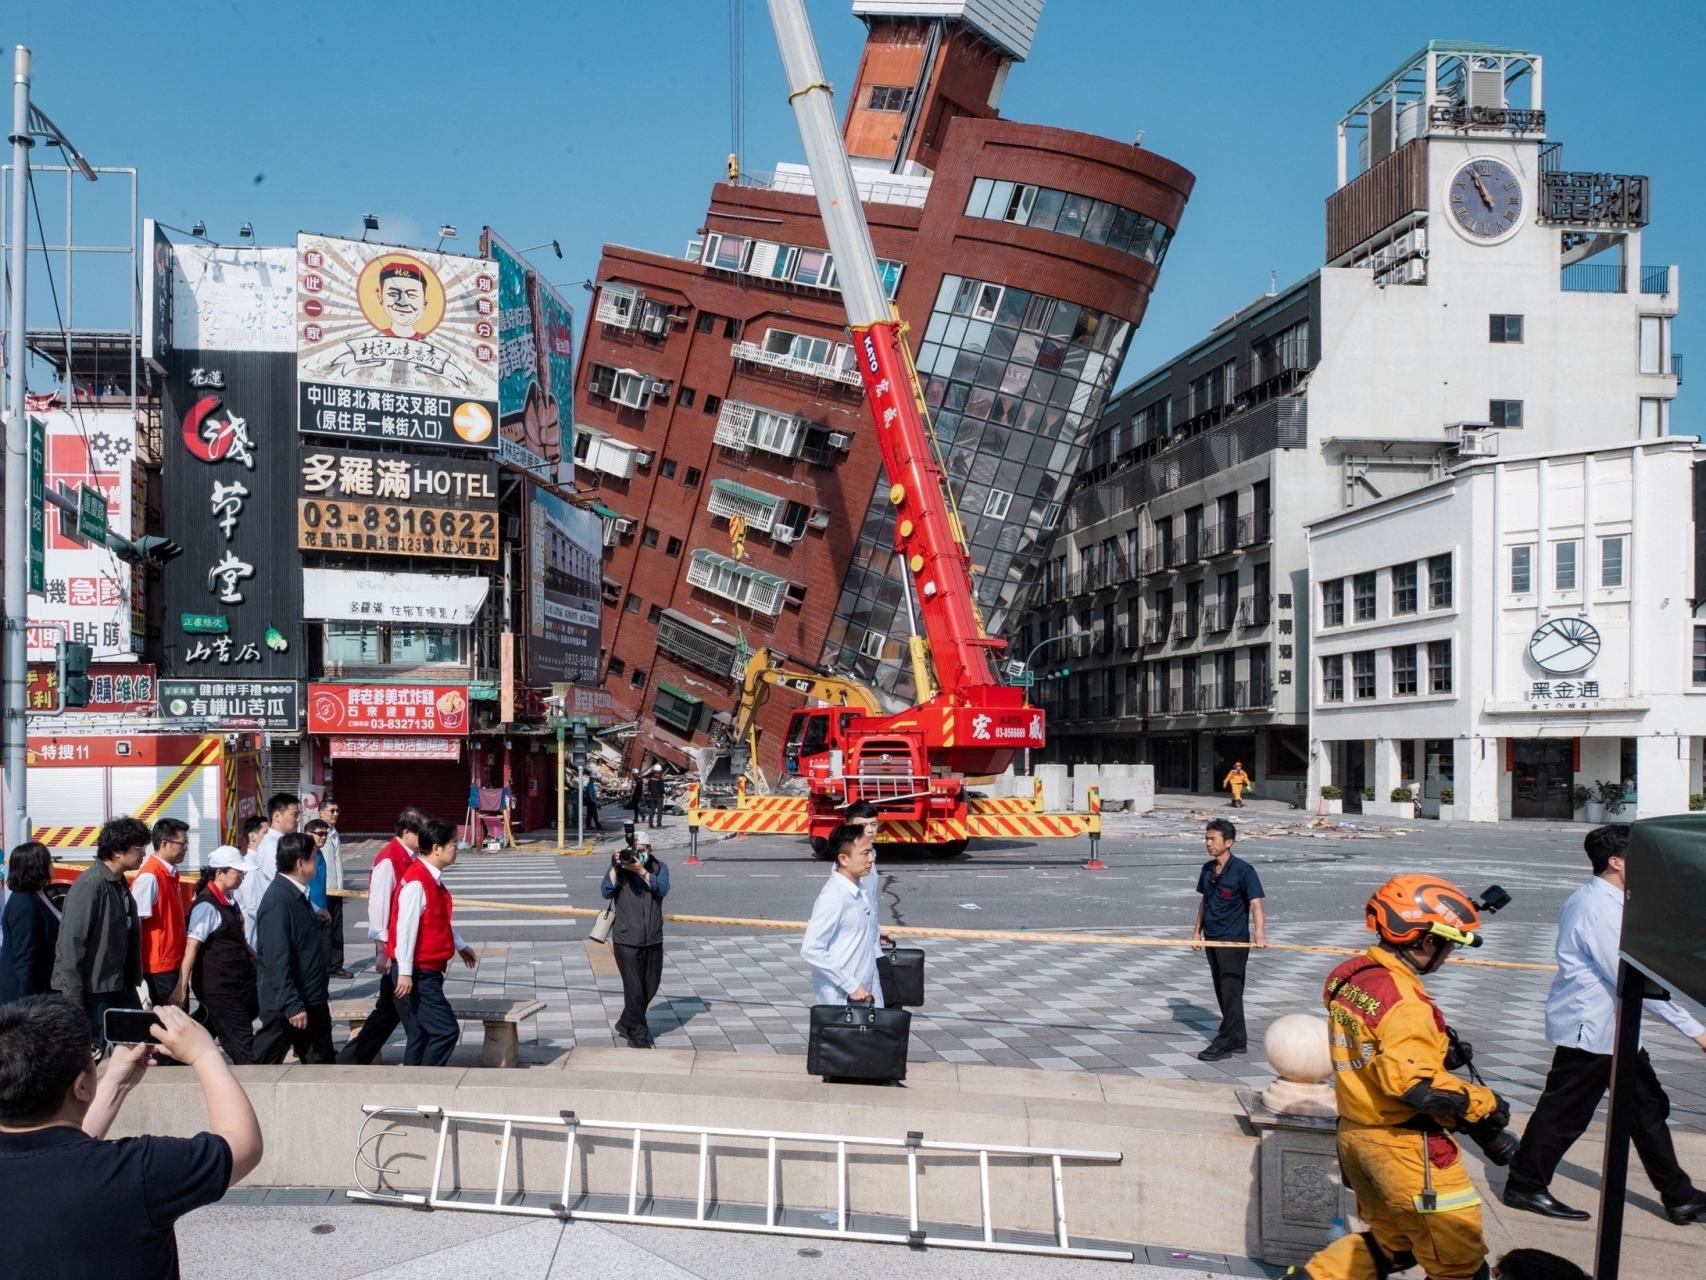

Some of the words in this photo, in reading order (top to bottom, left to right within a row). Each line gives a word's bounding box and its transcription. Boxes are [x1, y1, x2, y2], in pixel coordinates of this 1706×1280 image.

[303, 250, 323, 341] 僅此一家
[477, 276, 494, 362] 別無分號
[864, 336, 878, 372] KATO
[190, 368, 225, 388] 花蓮
[307, 385, 450, 417] 中山路北濱街交叉路口
[316, 410, 443, 440] (原住民一條街入口)
[302, 453, 411, 500] 多羅滿
[414, 469, 496, 499] HOTEL
[304, 501, 496, 540] 03-8316622
[186, 635, 261, 662] 山苦瓜
[91, 675, 151, 704] 購維修
[200, 684, 261, 696] 健康伴手禮
[796, 680, 809, 691] CAT
[1531, 682, 1600, 699] 黑金通
[191, 699, 284, 716] 有機山苦瓜
[370, 719, 434, 730] 03-8327130
[41, 744, 90, 760] 特搜11
